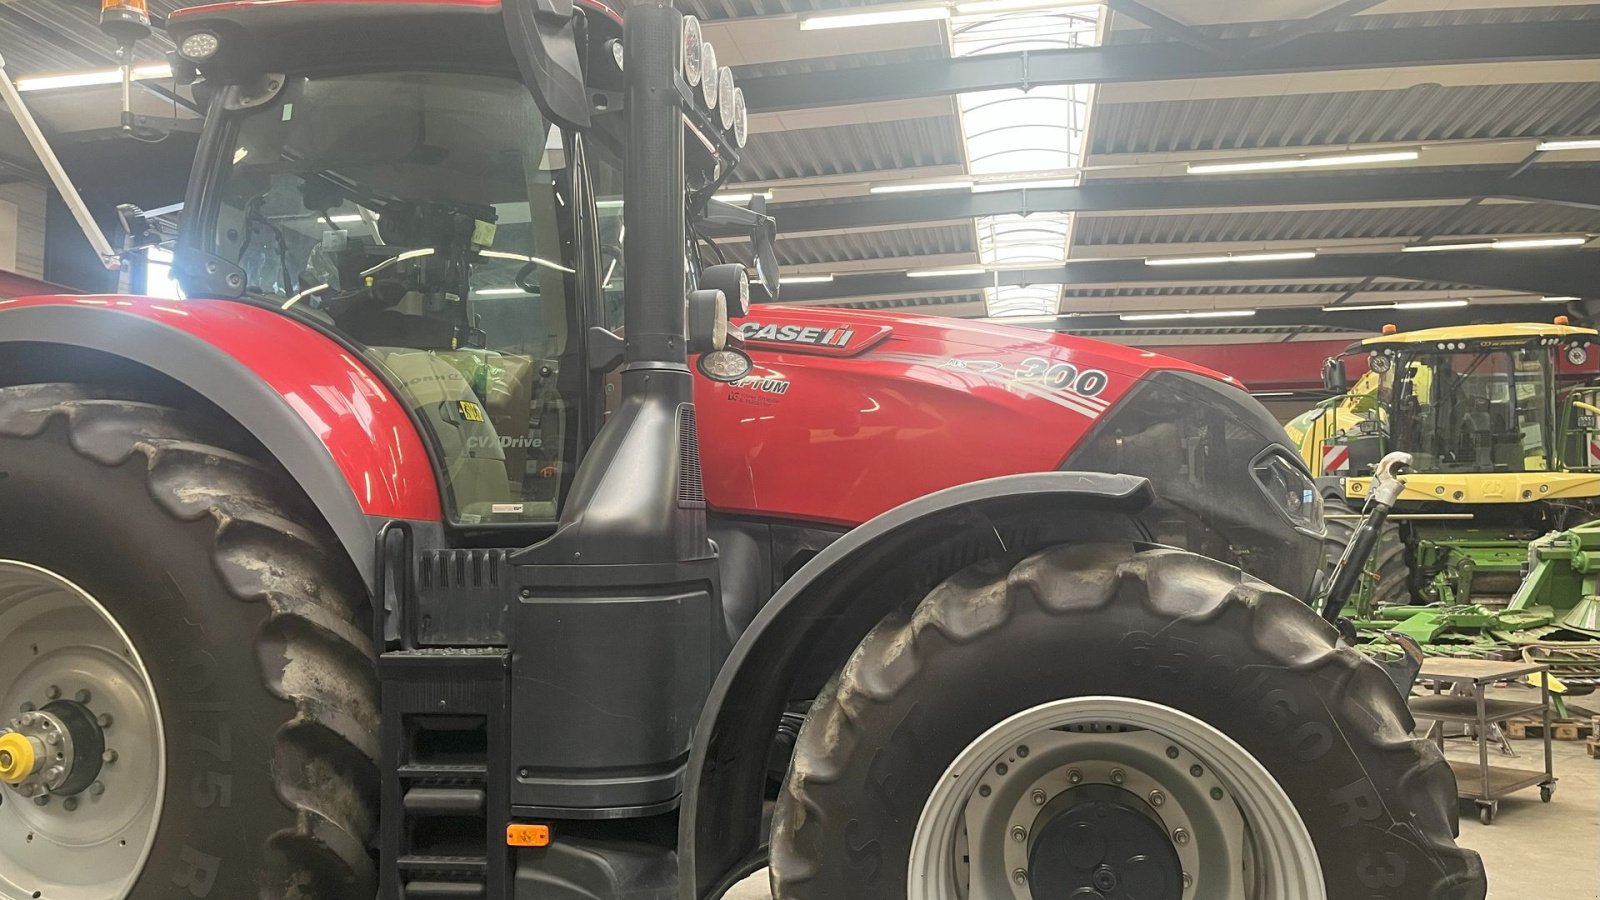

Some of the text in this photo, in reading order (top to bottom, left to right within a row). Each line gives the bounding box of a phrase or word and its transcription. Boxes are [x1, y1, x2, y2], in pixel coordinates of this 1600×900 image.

[739, 322, 820, 343] CASE
[1015, 357, 1108, 398] 300
[466, 435, 542, 448] CVXDrive
[1356, 850, 1407, 900] 3
